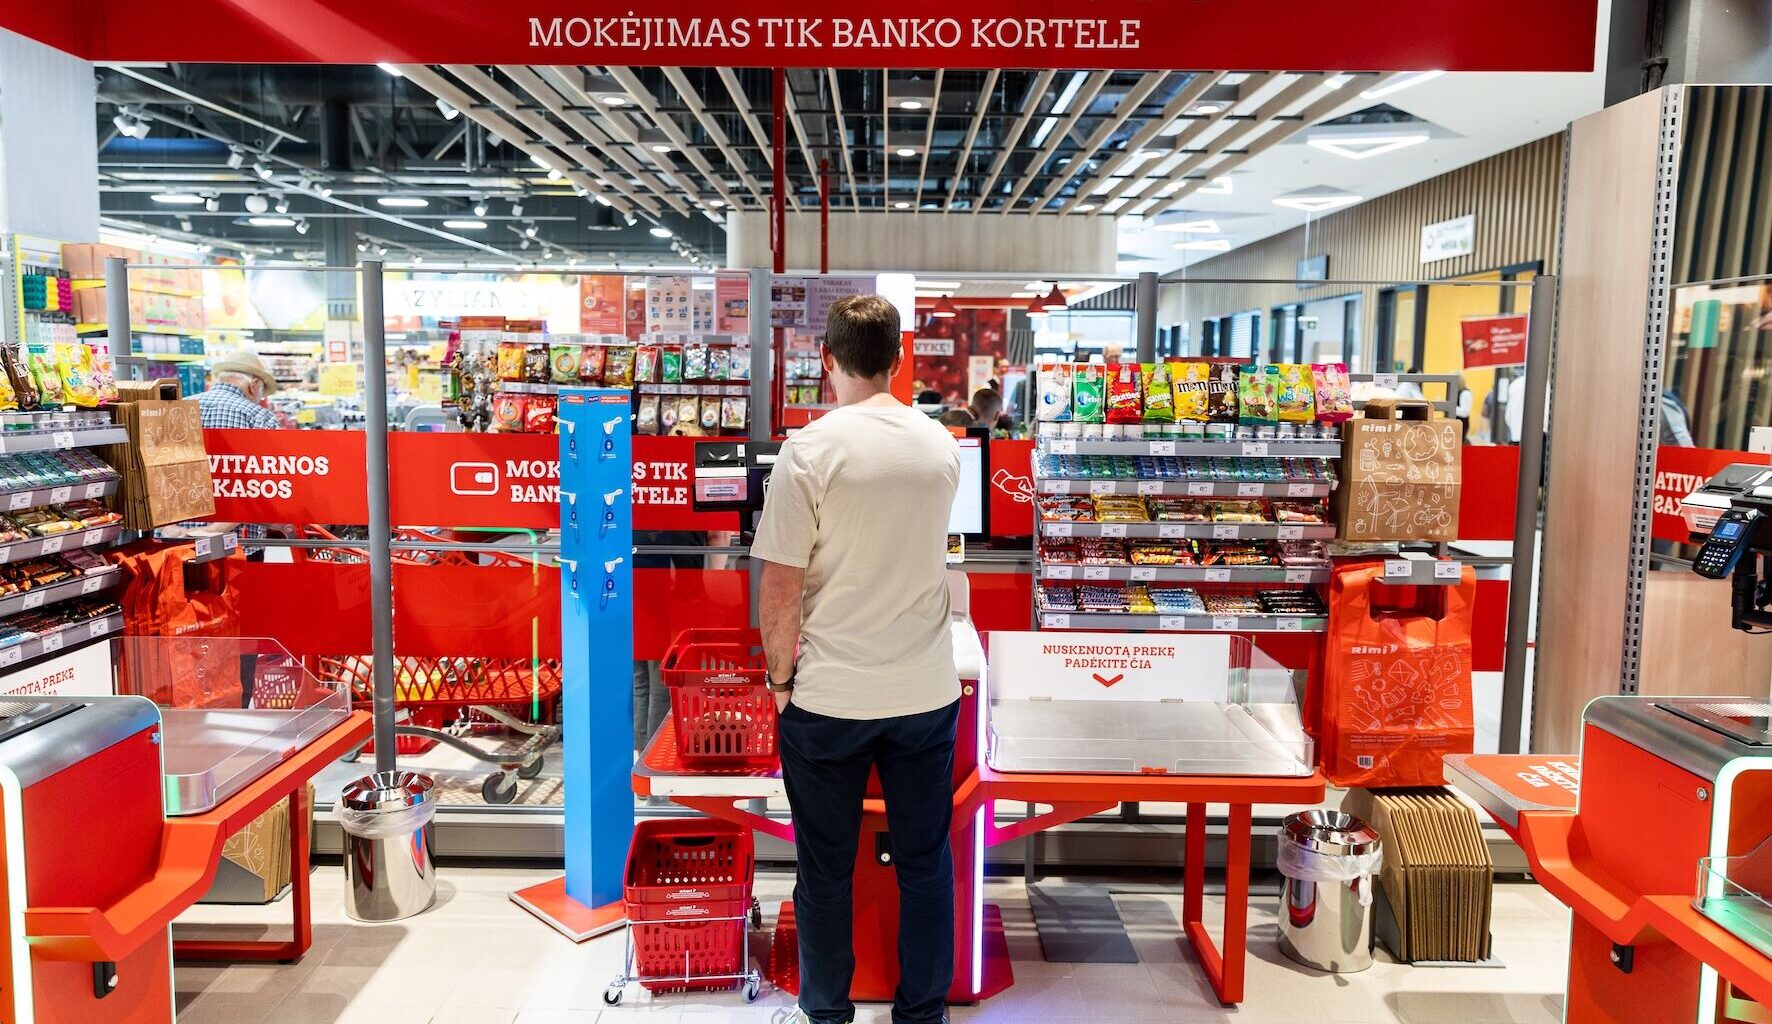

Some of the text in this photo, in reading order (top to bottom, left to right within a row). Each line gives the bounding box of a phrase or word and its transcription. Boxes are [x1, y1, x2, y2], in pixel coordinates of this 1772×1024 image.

[529, 11, 1141, 50] MOKĖJIMAS TIK BANKO KORTELE
[650, 462, 688, 480] TIK
[213, 478, 293, 499] KASOS
[632, 486, 688, 504] TELE
[1043, 645, 1175, 659] NUSKENUOTĄ PREKĘ
[1065, 657, 1152, 669] PADĖKITE ČIA
